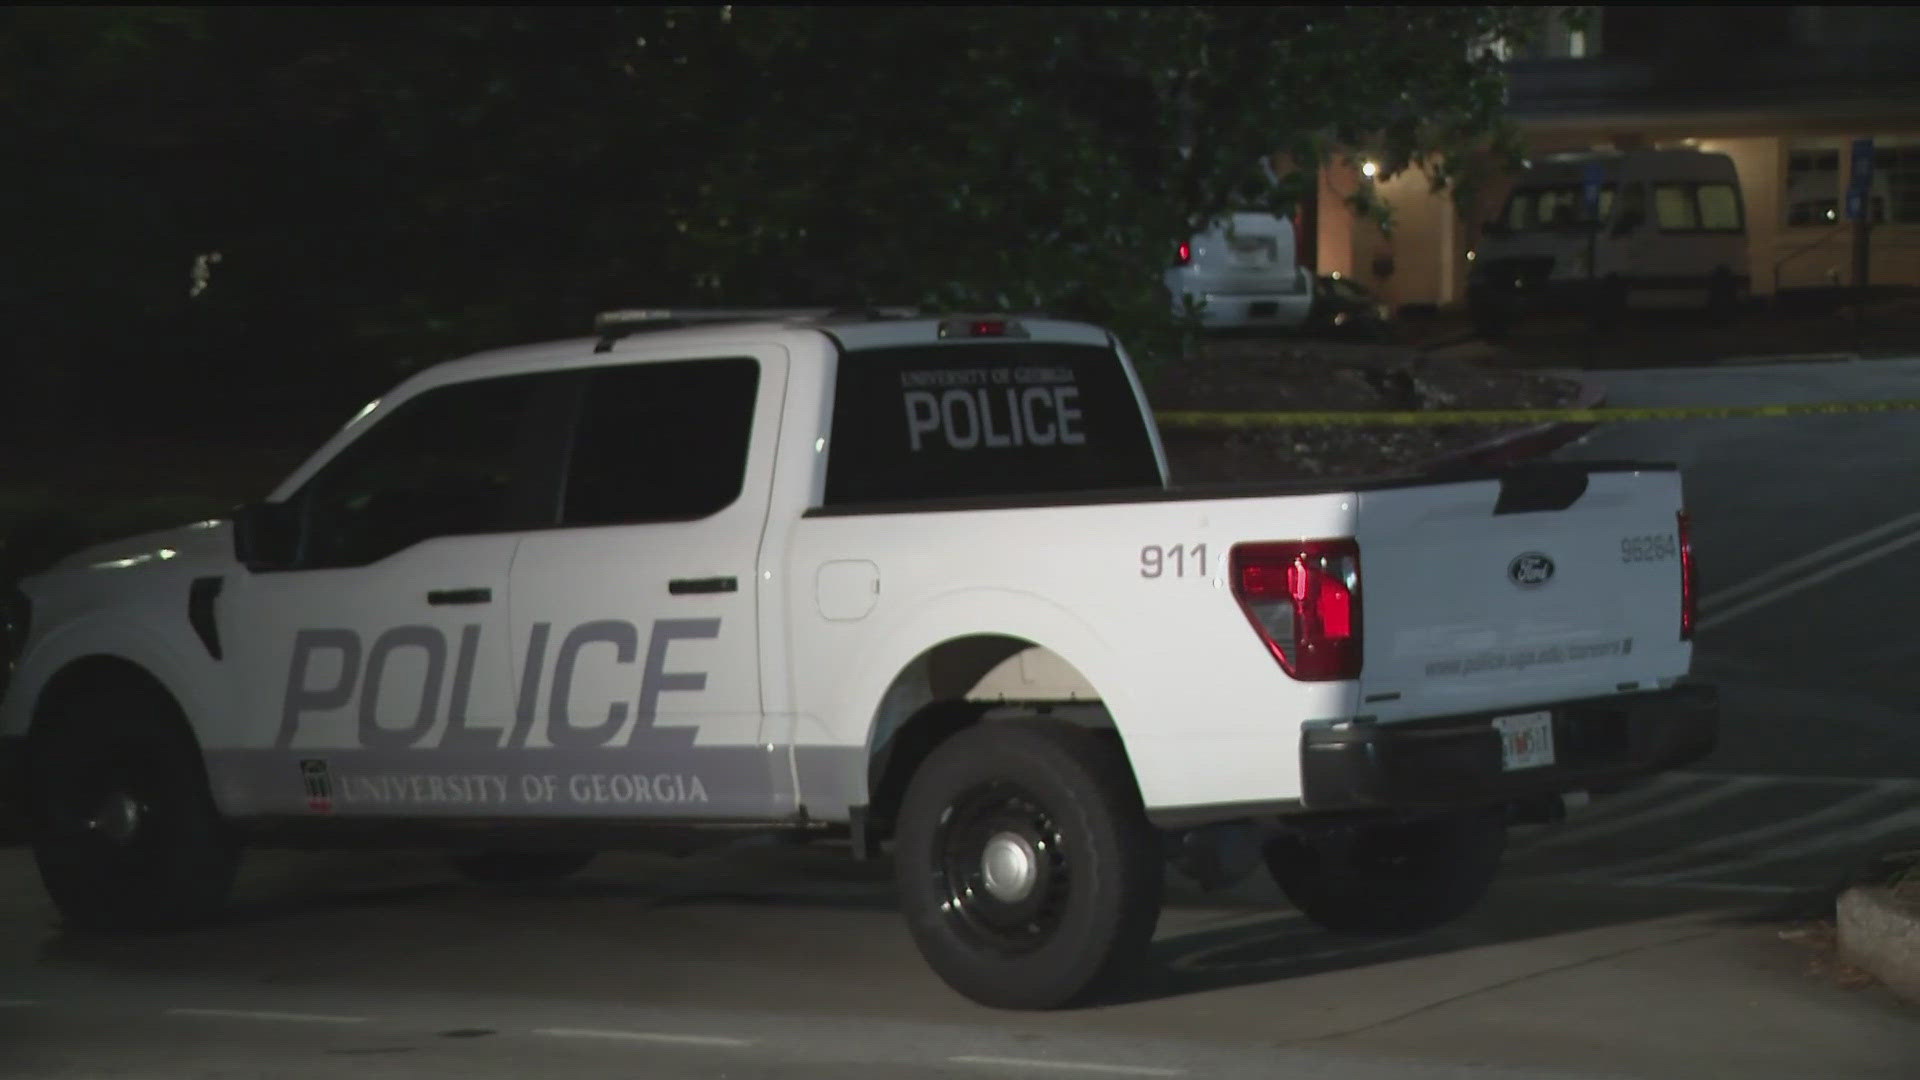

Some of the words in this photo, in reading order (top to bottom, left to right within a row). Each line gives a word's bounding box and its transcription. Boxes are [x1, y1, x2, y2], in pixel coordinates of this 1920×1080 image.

[900, 369, 988, 387] UNIVERSITY
[990, 368, 1009, 385] OF
[1014, 366, 1075, 384] GEORGIA
[903, 386, 1086, 451] POLICE
[1140, 543, 1207, 578] 911
[274, 617, 722, 748] POLICE
[340, 773, 508, 803] UNIVERSITY
[519, 773, 560, 803] OF
[568, 773, 710, 803] GEORGIA
